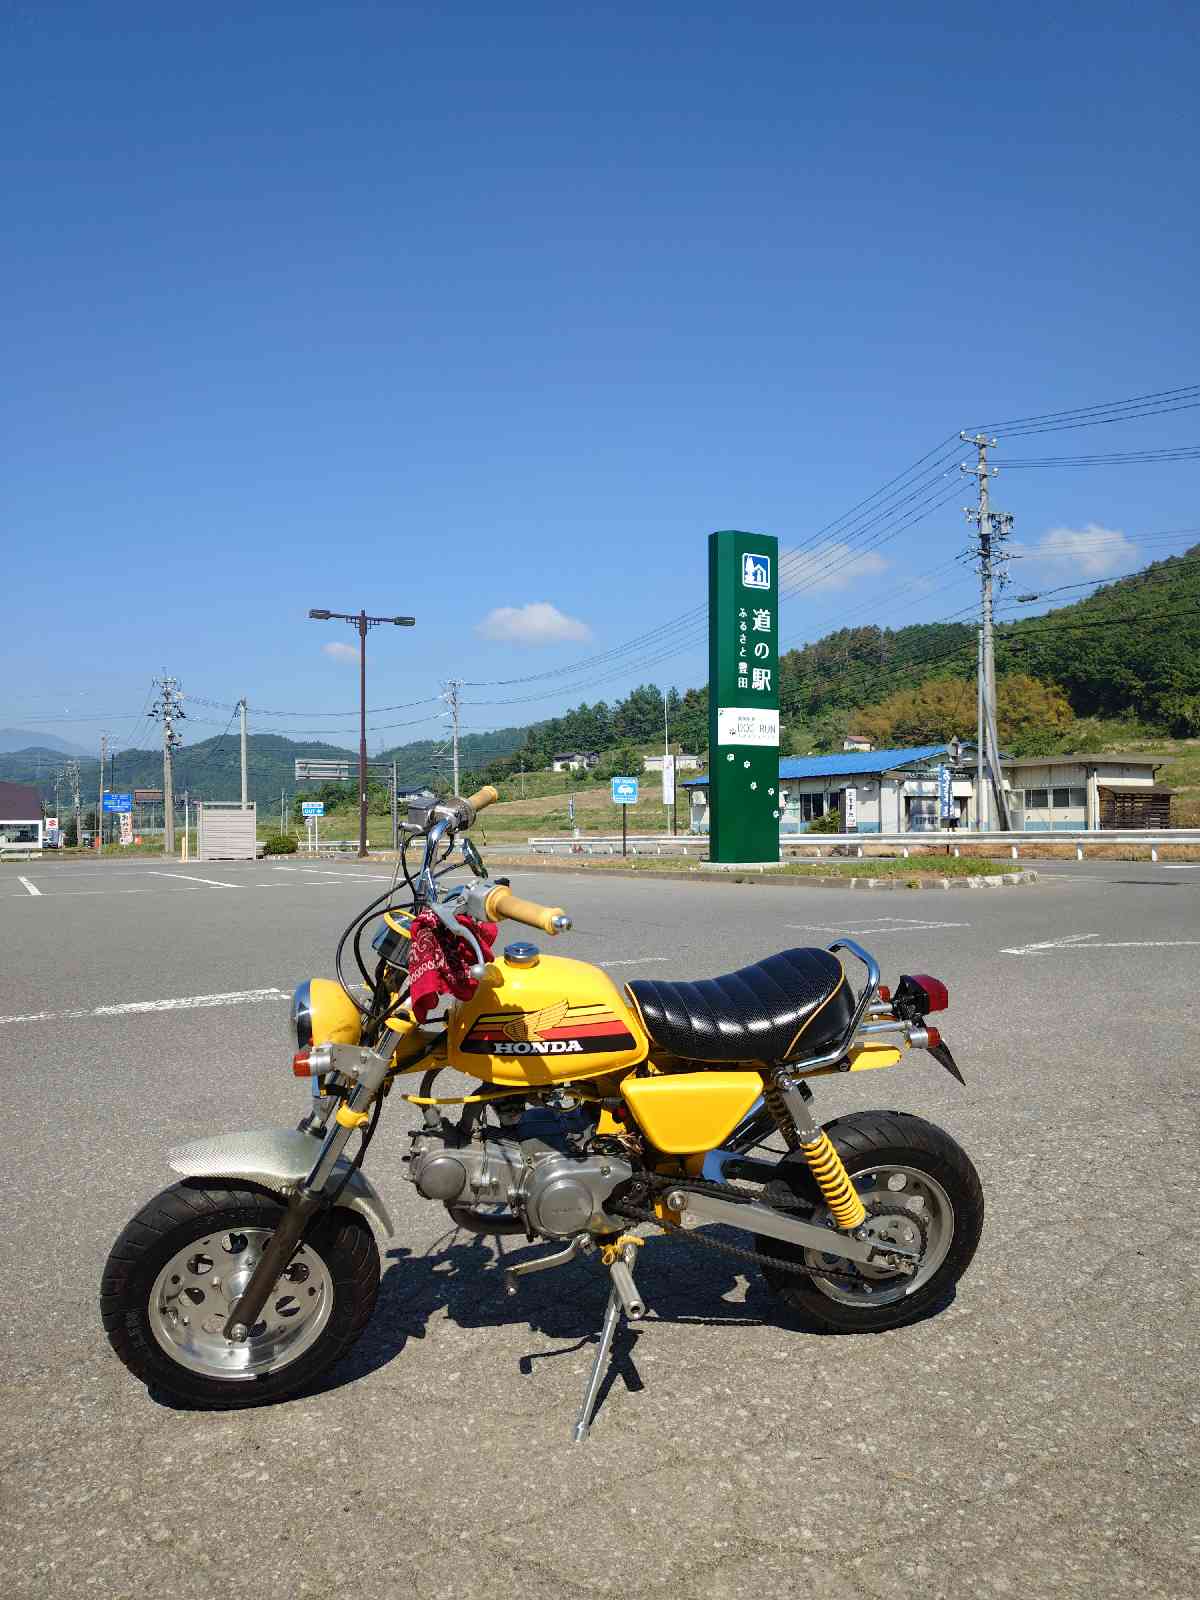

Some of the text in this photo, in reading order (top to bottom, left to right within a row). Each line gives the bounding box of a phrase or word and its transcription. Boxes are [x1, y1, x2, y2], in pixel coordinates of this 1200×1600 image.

[752, 608, 771, 692] 道の駅
[759, 724, 776, 734] RUN
[494, 1040, 583, 1054] HONDA
